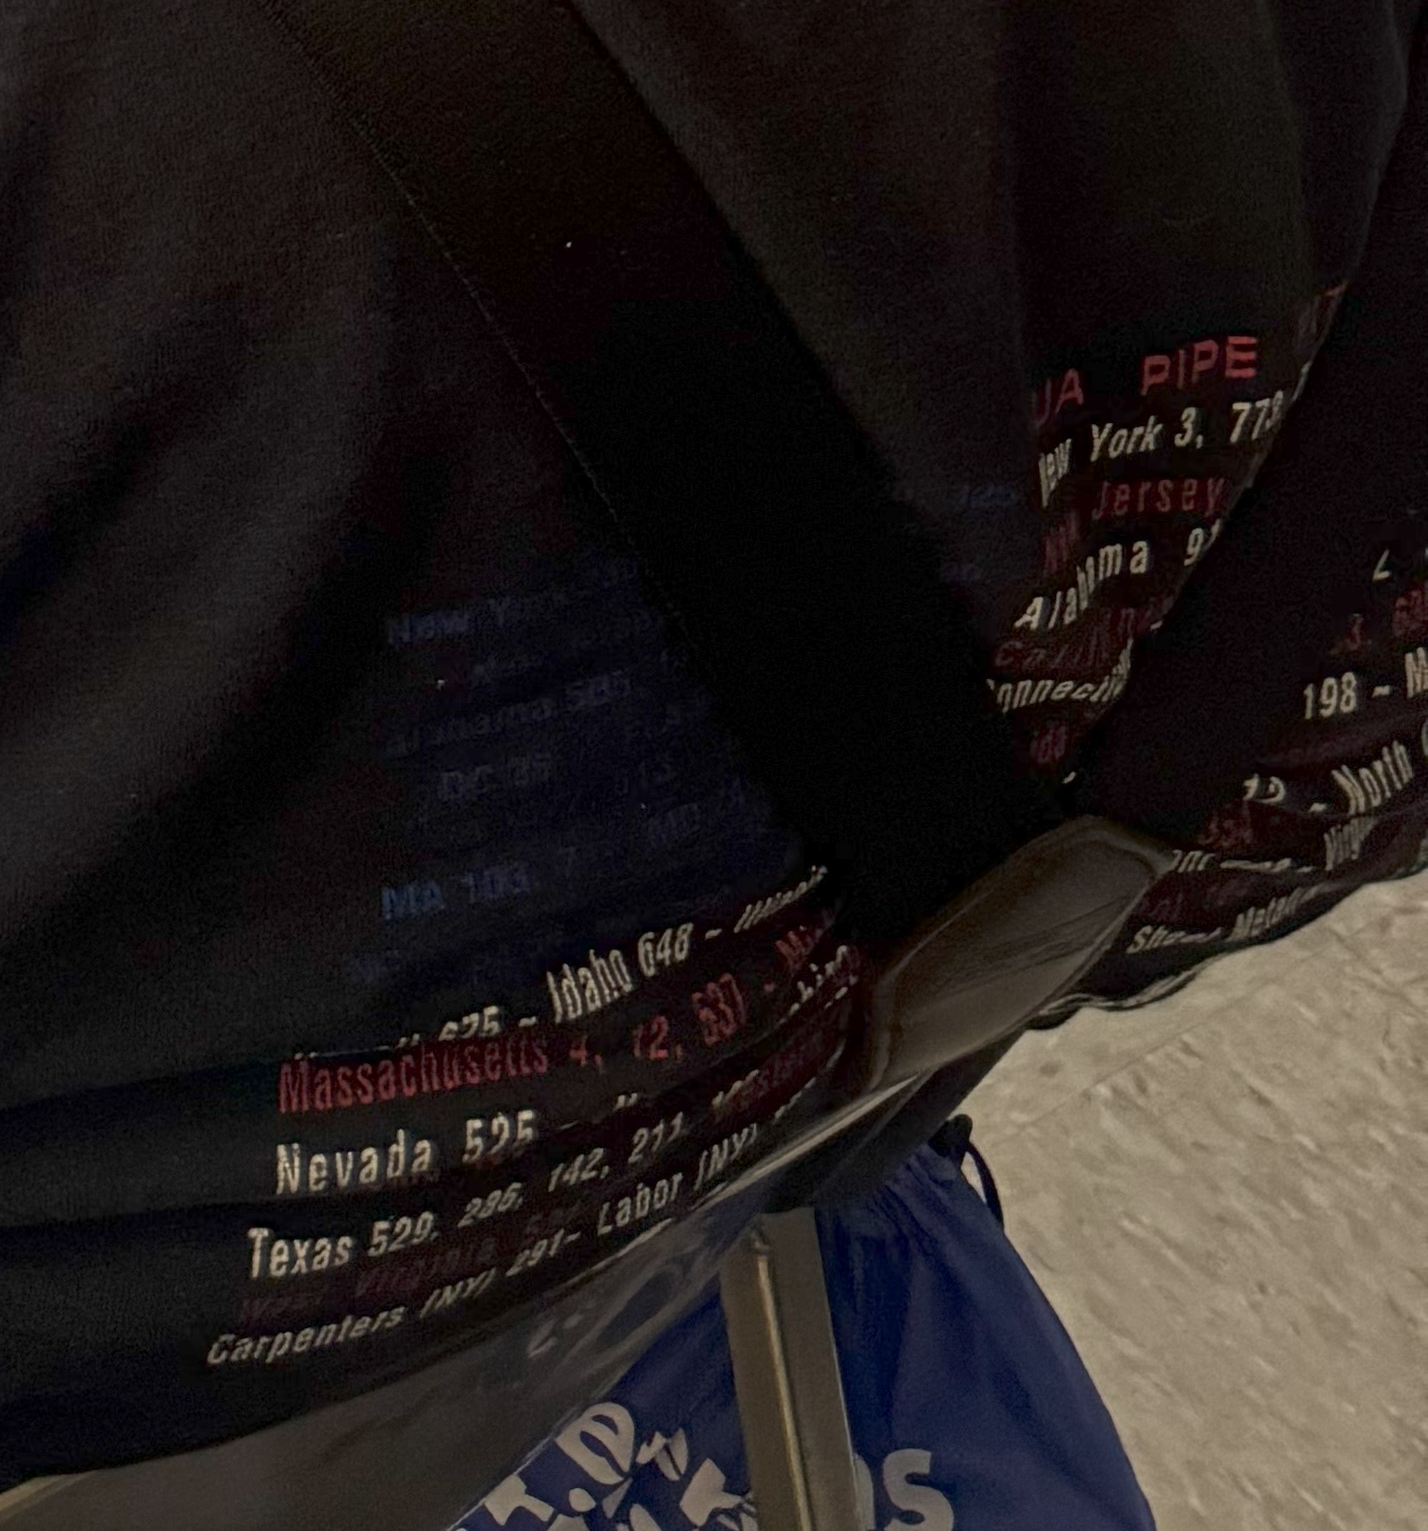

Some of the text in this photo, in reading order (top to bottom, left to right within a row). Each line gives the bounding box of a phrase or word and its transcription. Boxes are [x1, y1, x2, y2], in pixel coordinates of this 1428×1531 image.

[1141, 335, 1258, 397] PIPE
[1086, 417, 1162, 456] York
[1303, 671, 1357, 719] 198
[546, 947, 632, 1022] Idaho
[272, 1131, 439, 1196] Nevada
[207, 1306, 405, 1367] Carpenters
[597, 1171, 683, 1236] Labor
[247, 1228, 355, 1278] Texas
